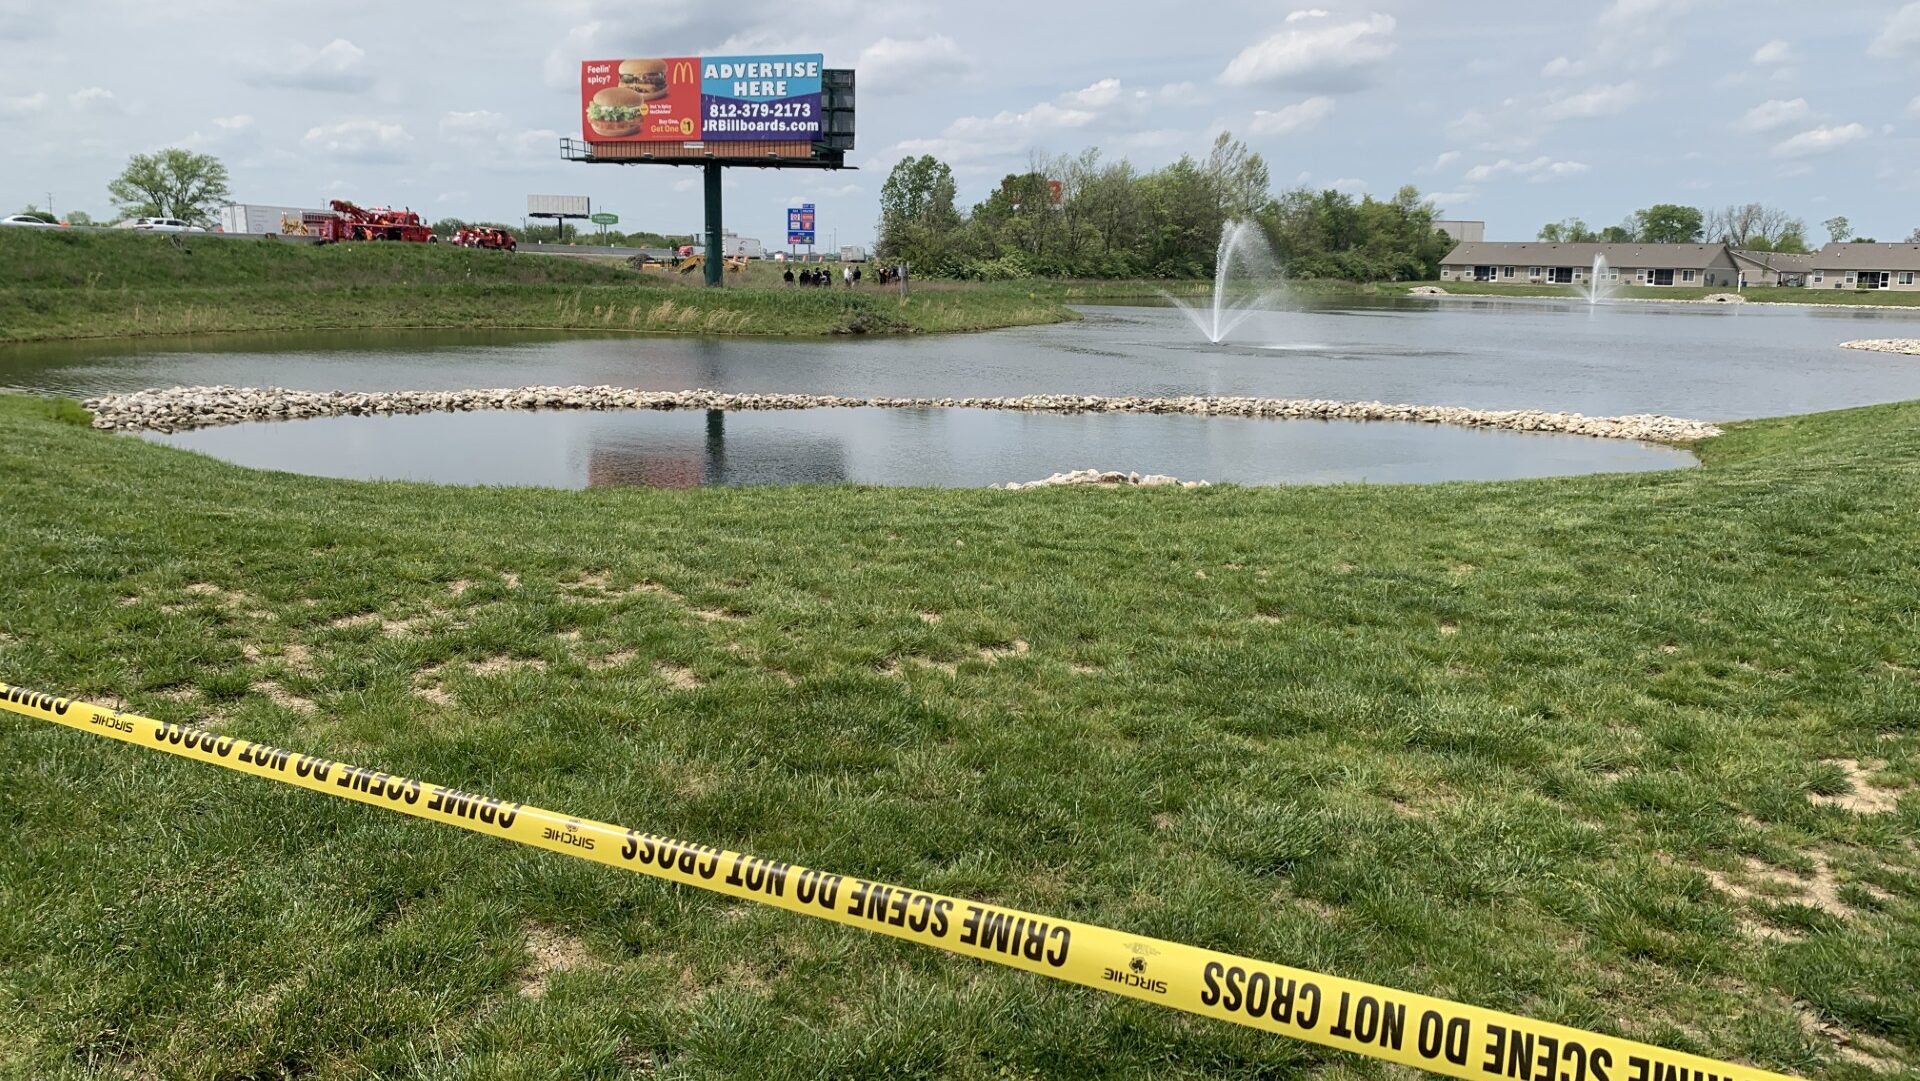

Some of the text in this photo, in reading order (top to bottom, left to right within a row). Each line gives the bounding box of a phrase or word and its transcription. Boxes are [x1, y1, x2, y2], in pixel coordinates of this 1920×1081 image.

[587, 65, 611, 74] Feelin'
[587, 75, 611, 85] spicy?
[704, 62, 819, 80] ADVERTISE
[733, 81, 788, 97] HERE
[709, 103, 811, 118] 812-379-2173
[650, 125, 679, 133] Get One
[702, 119, 819, 132] JRBillboards.com
[91, 713, 134, 733] SIRCHIE
[337, 766, 421, 805] SCENE
[428, 786, 521, 829] CRIME
[542, 827, 596, 850] SIRCHIE
[621, 829, 1071, 967] CRIME SCENE DO NOT CROSS
[1102, 967, 1168, 994] SIRCHIE
[1201, 961, 1321, 1030] CROSS
[1330, 991, 1406, 1051] NOT
[1418, 1010, 1471, 1066] DO
[1482, 1024, 1613, 1081] SCENE
